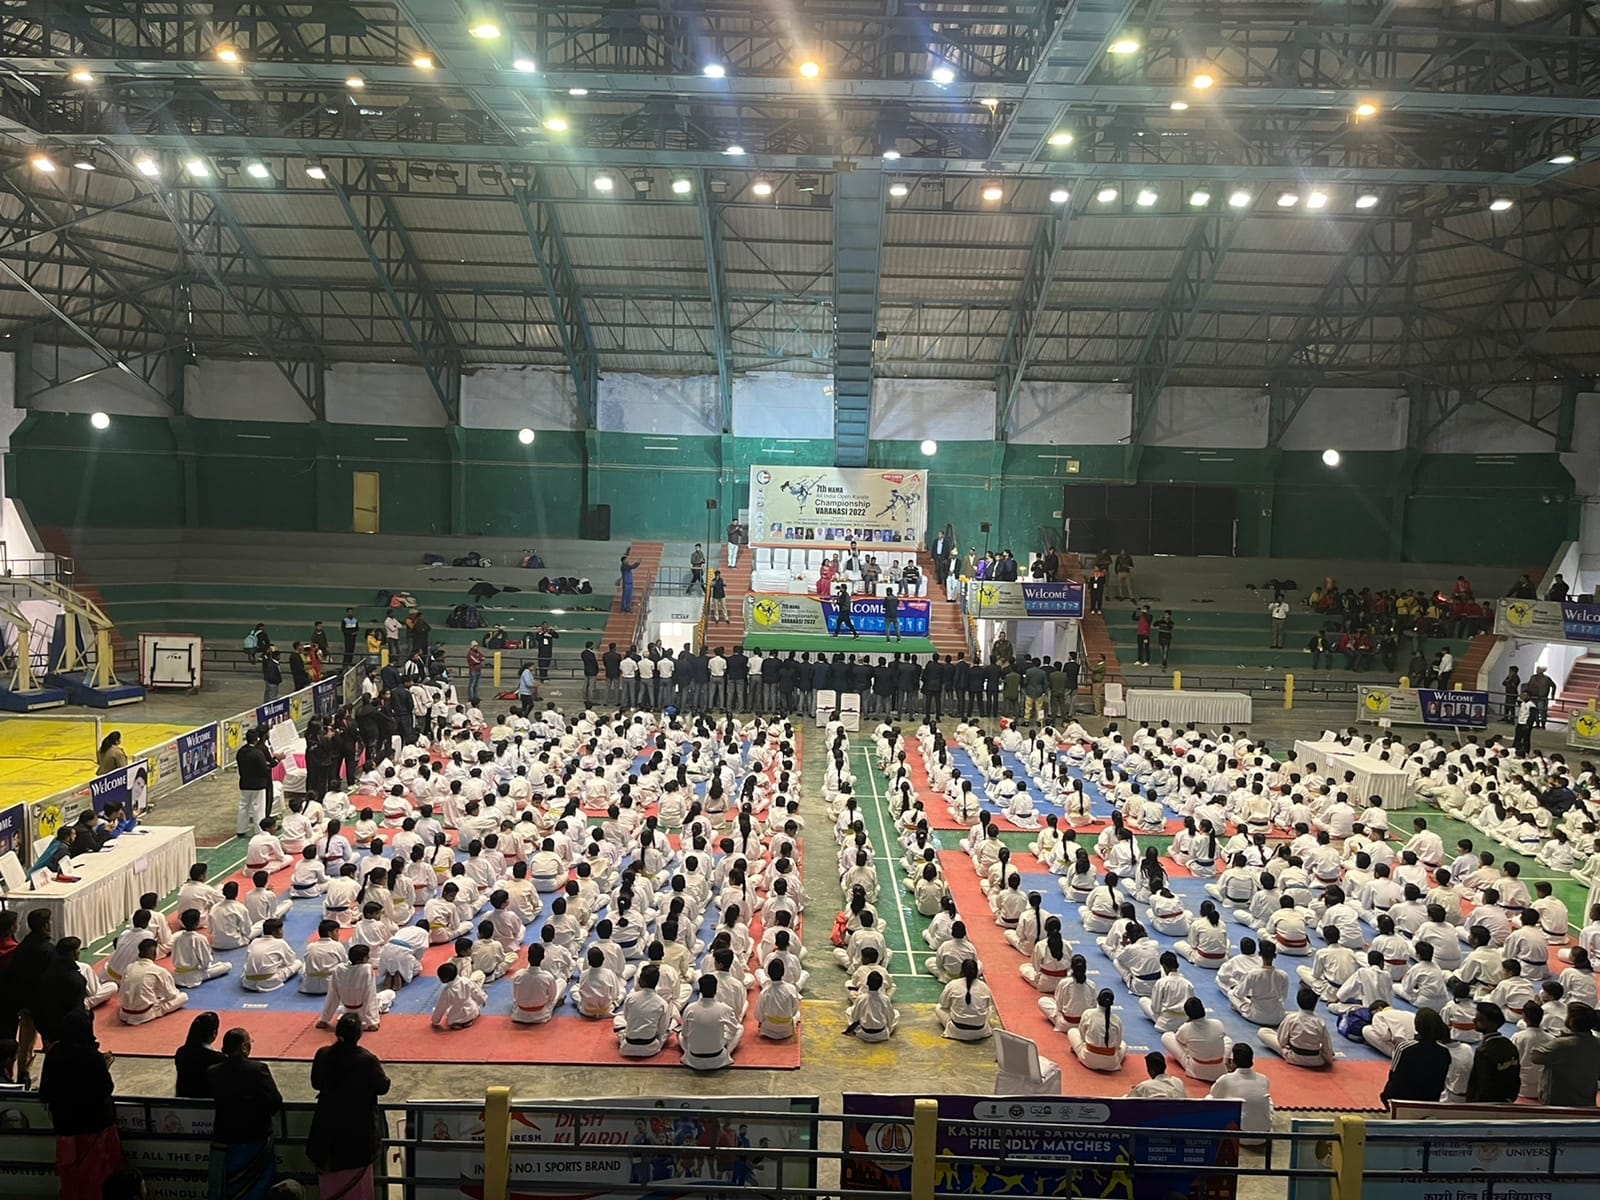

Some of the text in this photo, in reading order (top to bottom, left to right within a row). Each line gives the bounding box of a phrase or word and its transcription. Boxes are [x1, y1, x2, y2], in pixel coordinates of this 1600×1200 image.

[815, 499, 871, 509] Championship
[816, 507, 866, 516] VARANASI 2022
[948, 1126, 991, 1136] KASHI
[970, 1138, 1111, 1152] FRIENDLY MATCHES
[142, 1151, 164, 1161] ALL
[167, 1152, 192, 1162] THE
[515, 1163, 541, 1173] NO.1
[545, 1161, 582, 1173] SPORTS
[585, 1160, 621, 1172] BRAND
